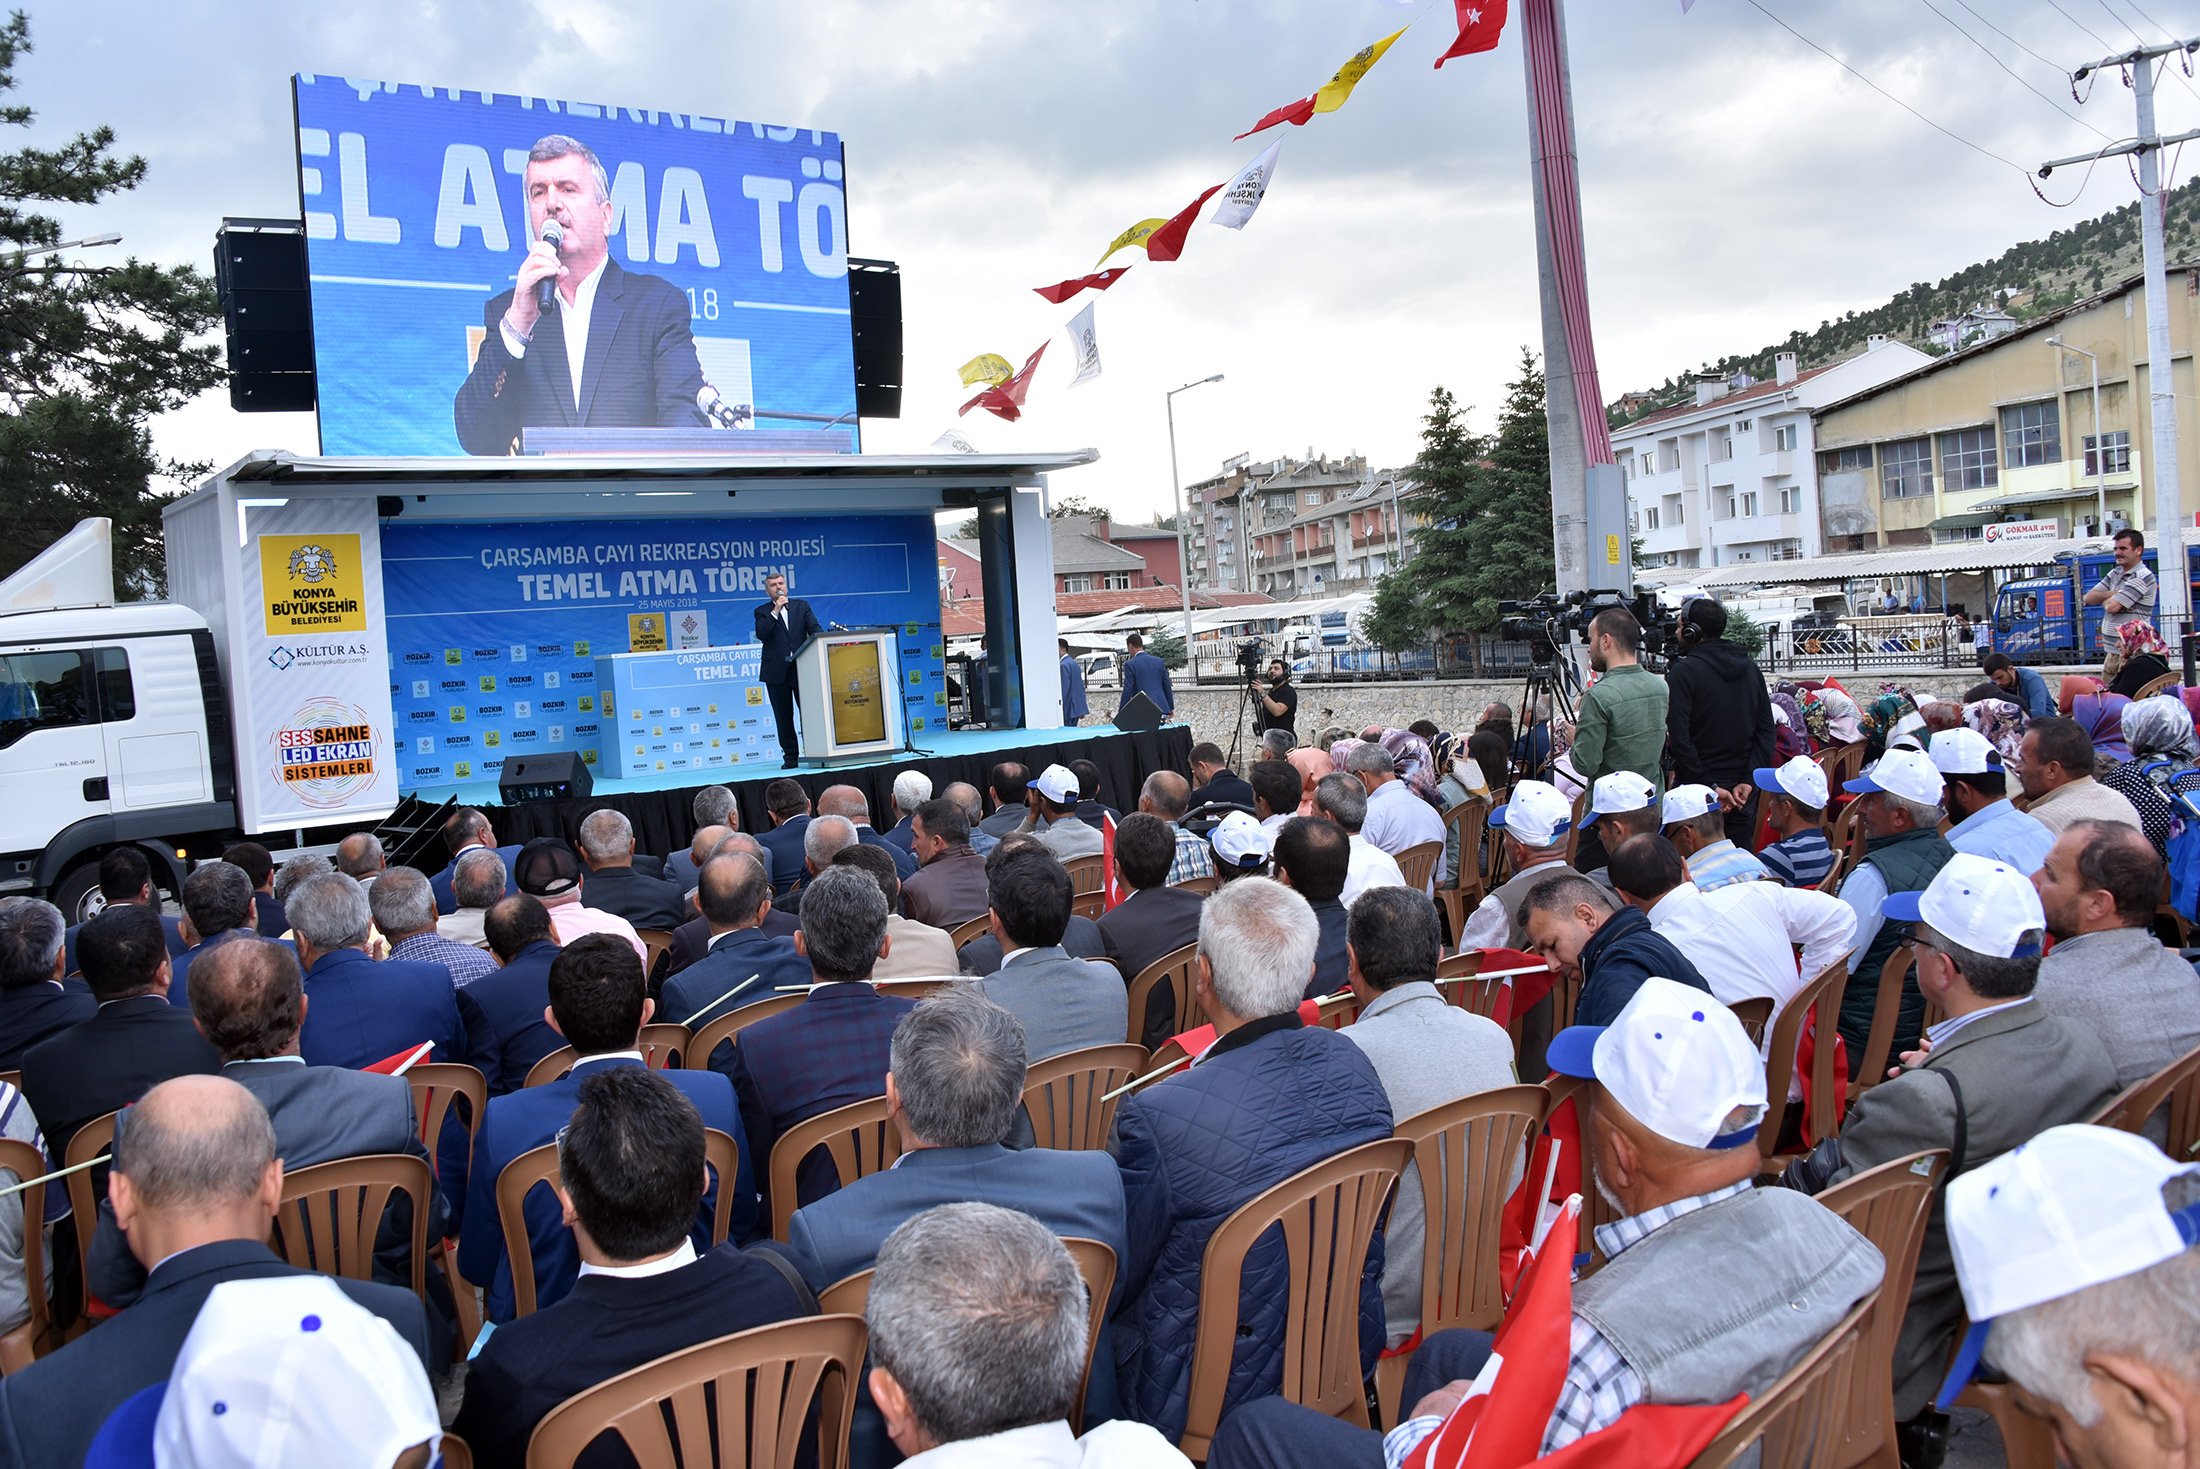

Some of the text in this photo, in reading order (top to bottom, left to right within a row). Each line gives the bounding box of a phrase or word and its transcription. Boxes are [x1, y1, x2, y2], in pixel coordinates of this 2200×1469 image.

[481, 535, 826, 569] ÇARŞAMBA ÇAYI REKREASYON PROJESİ
[517, 572, 611, 601] TEMEL
[619, 569, 698, 597] ATMA
[293, 588, 336, 599] KONYA
[272, 597, 358, 616] BÜYÜKŞEHİR
[638, 597, 698, 609] 25 MAYIS 2018
[291, 614, 342, 625] BELEDİYESİ
[296, 644, 345, 658] KÜLTÜR
[676, 649, 762, 665] ÇARŞAMBA ÇAYI RE
[694, 662, 761, 680] TEMEL AT
[441, 680, 466, 688] BOZKIR
[411, 711, 436, 719] BOZKIR
[479, 706, 502, 714] BOZKIR
[280, 725, 369, 747] SES SAHNE
[446, 736, 471, 744] BOZKIR
[513, 730, 537, 738] BOZKIR
[282, 741, 371, 764] LED EKRAN
[285, 759, 371, 780] SİSTEMLERİ
[416, 767, 440, 775] BOZKIR
